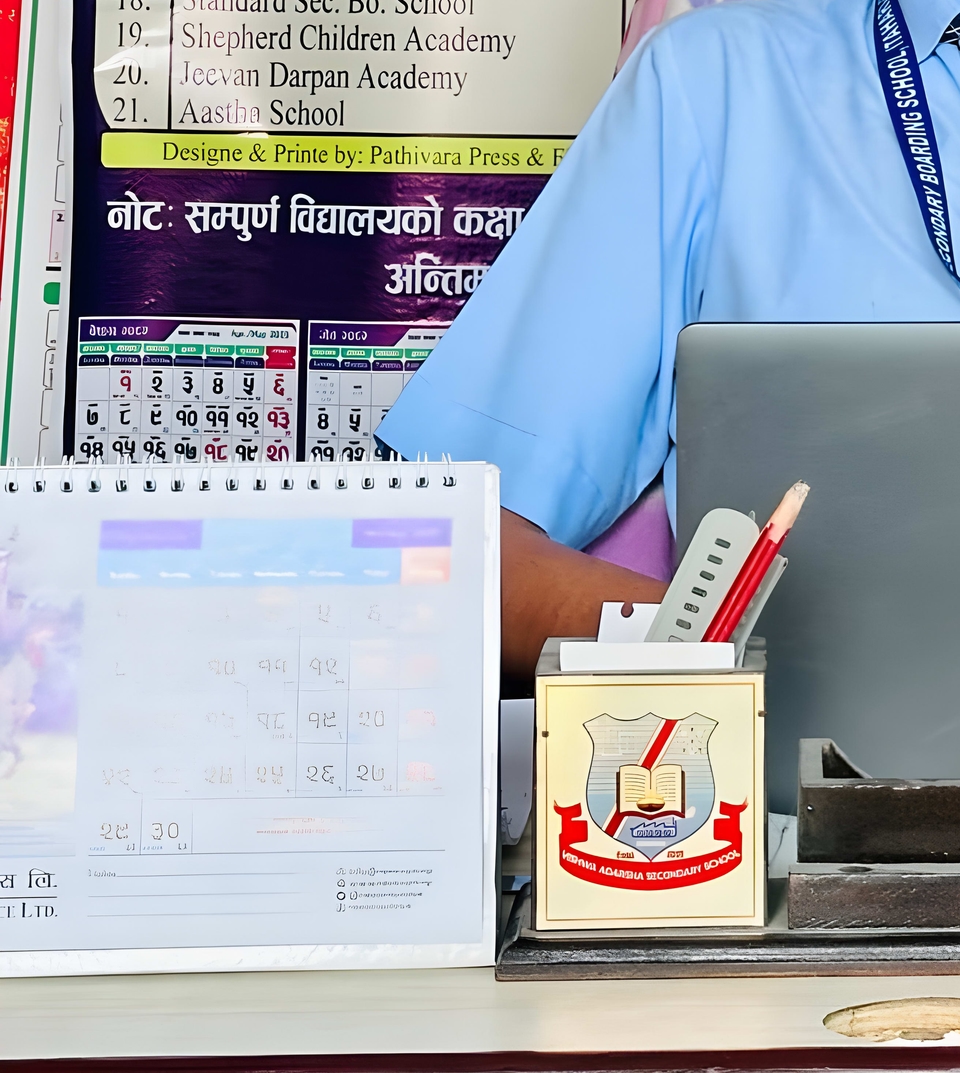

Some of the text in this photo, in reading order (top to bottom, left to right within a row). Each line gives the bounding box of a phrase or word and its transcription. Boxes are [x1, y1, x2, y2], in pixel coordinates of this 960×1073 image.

[182, 23, 516, 60] Shepherd Children Academy
[179, 61, 467, 96] Jeevan Darpan Academy
[178, 98, 344, 126] Aastha School
[163, 142, 242, 166] Designe
[249, 143, 267, 162] &
[274, 143, 328, 163] Printe
[335, 145, 362, 168] by:
[370, 145, 461, 165] Pathivara
[469, 147, 520, 166] Press
[527, 148, 544, 166] &
[901, 112, 939, 184] BOARDING
[185, 195, 280, 241] सम्पुर्ण
[290, 194, 444, 237] विद्यालयको
